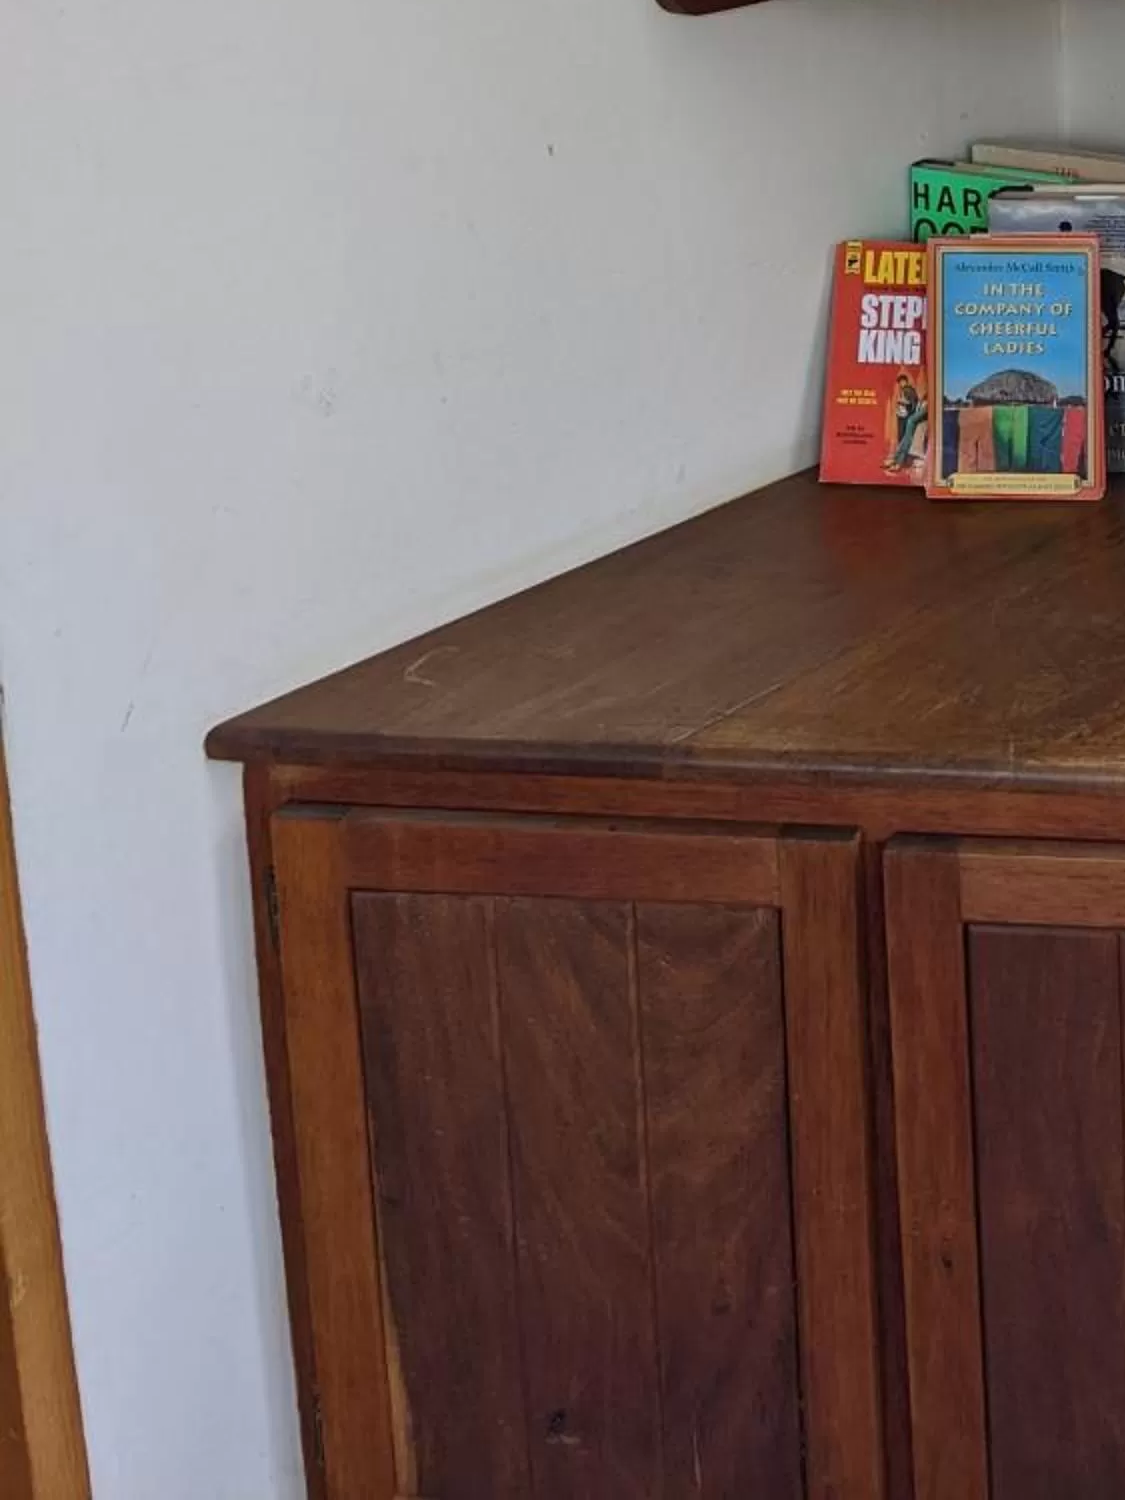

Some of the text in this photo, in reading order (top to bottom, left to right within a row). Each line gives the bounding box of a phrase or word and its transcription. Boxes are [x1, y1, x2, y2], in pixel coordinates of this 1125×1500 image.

[983, 282, 1045, 297] IN THE
[954, 302, 1073, 317] COMPANY OF
[968, 322, 1059, 338] CHEERFUL
[858, 329, 921, 365] KING
[983, 341, 1046, 357] LADIES
